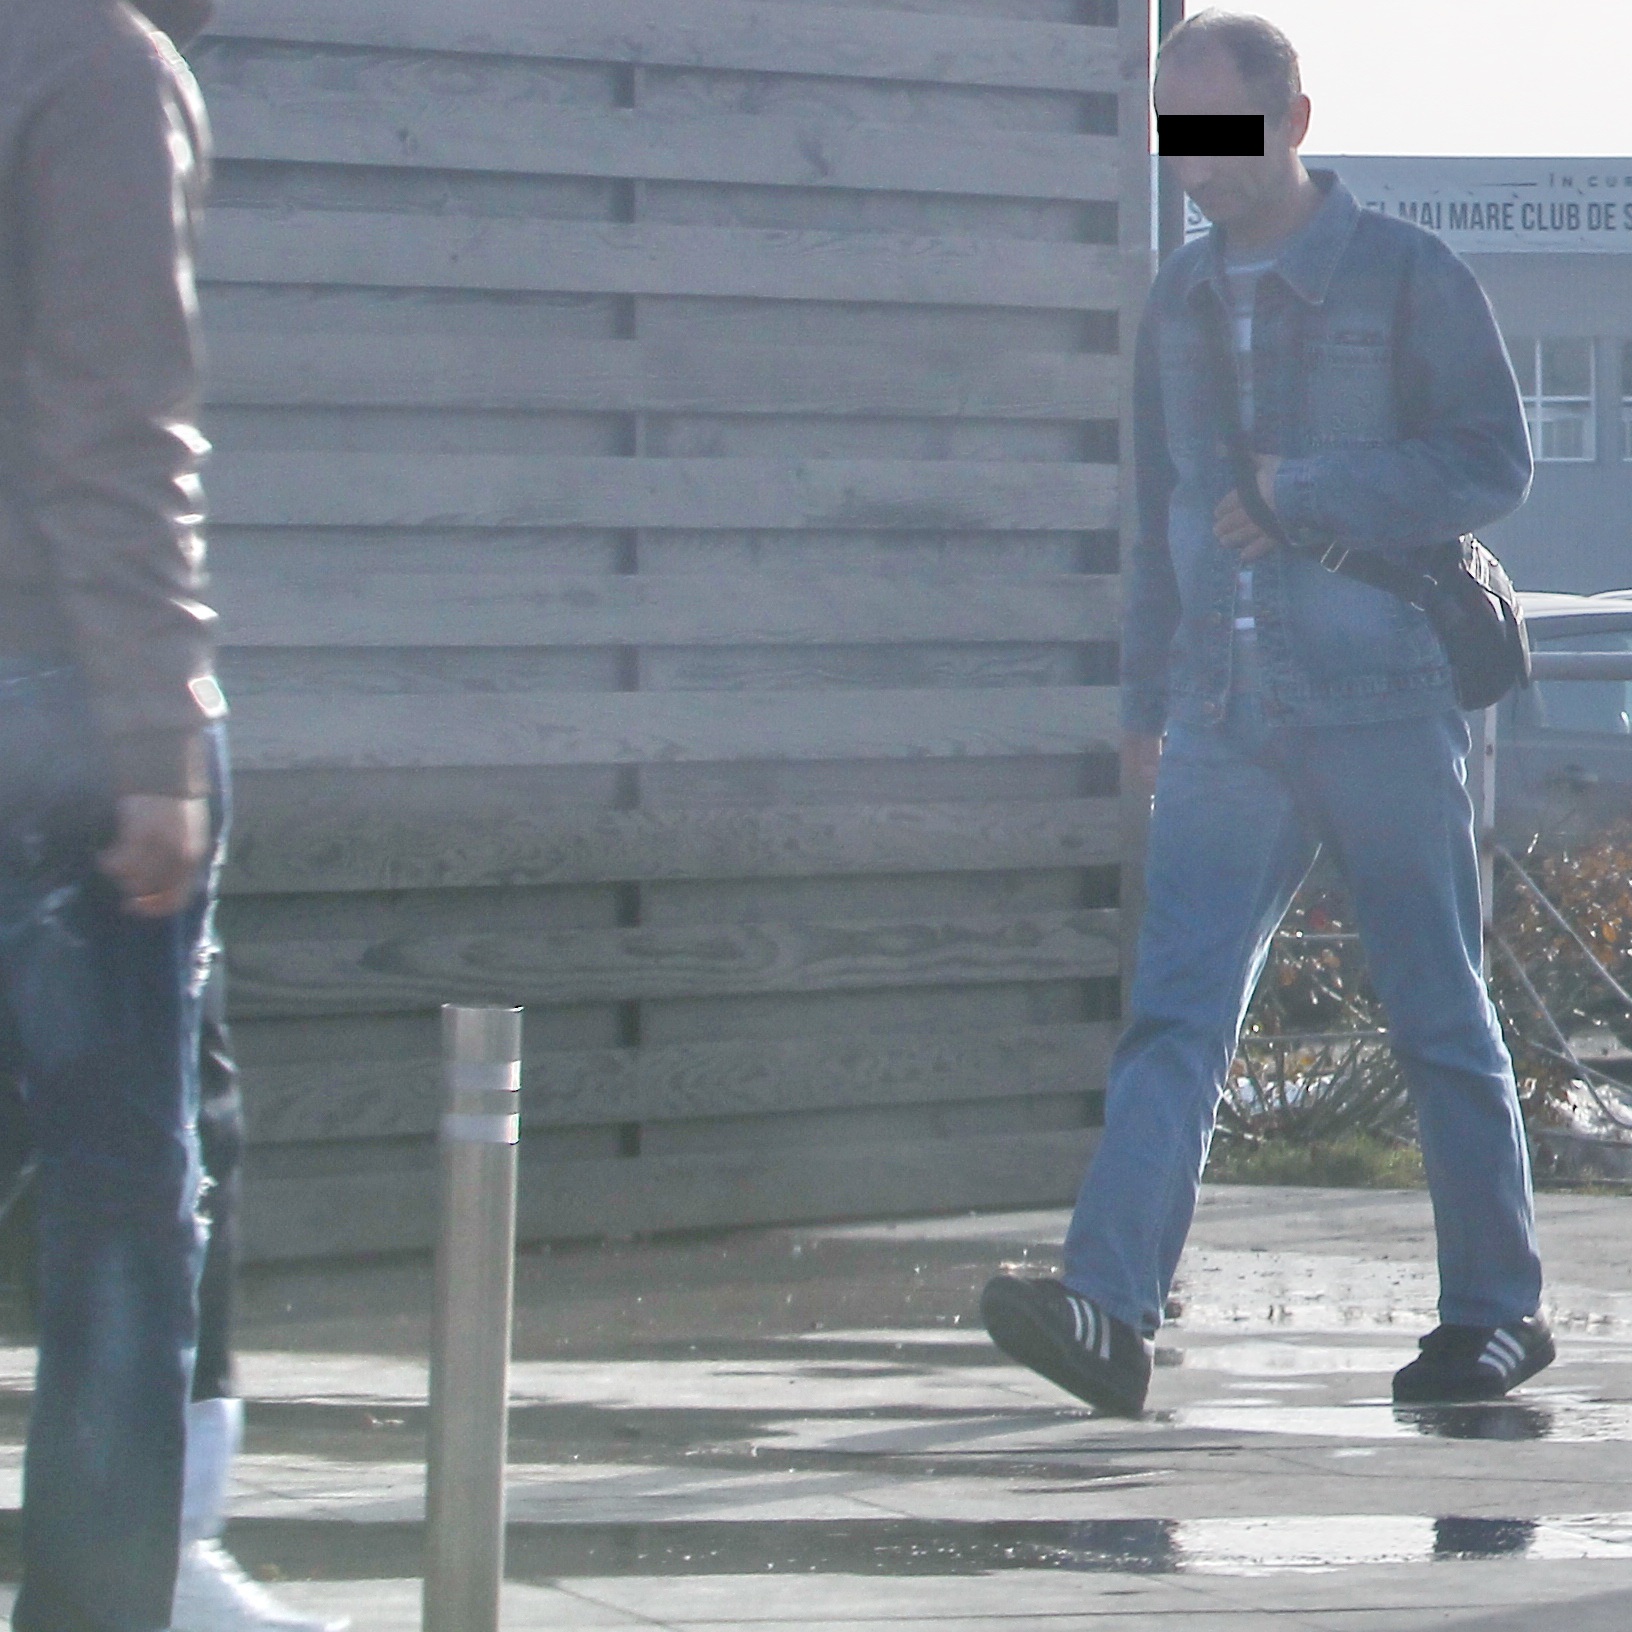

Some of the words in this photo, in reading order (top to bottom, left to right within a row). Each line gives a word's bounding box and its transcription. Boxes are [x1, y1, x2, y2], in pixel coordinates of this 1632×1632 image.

[1400, 201, 1441, 230] MAI
[1450, 201, 1515, 231] MARE
[1521, 202, 1581, 231] CLUB
[1587, 202, 1617, 231] DE
